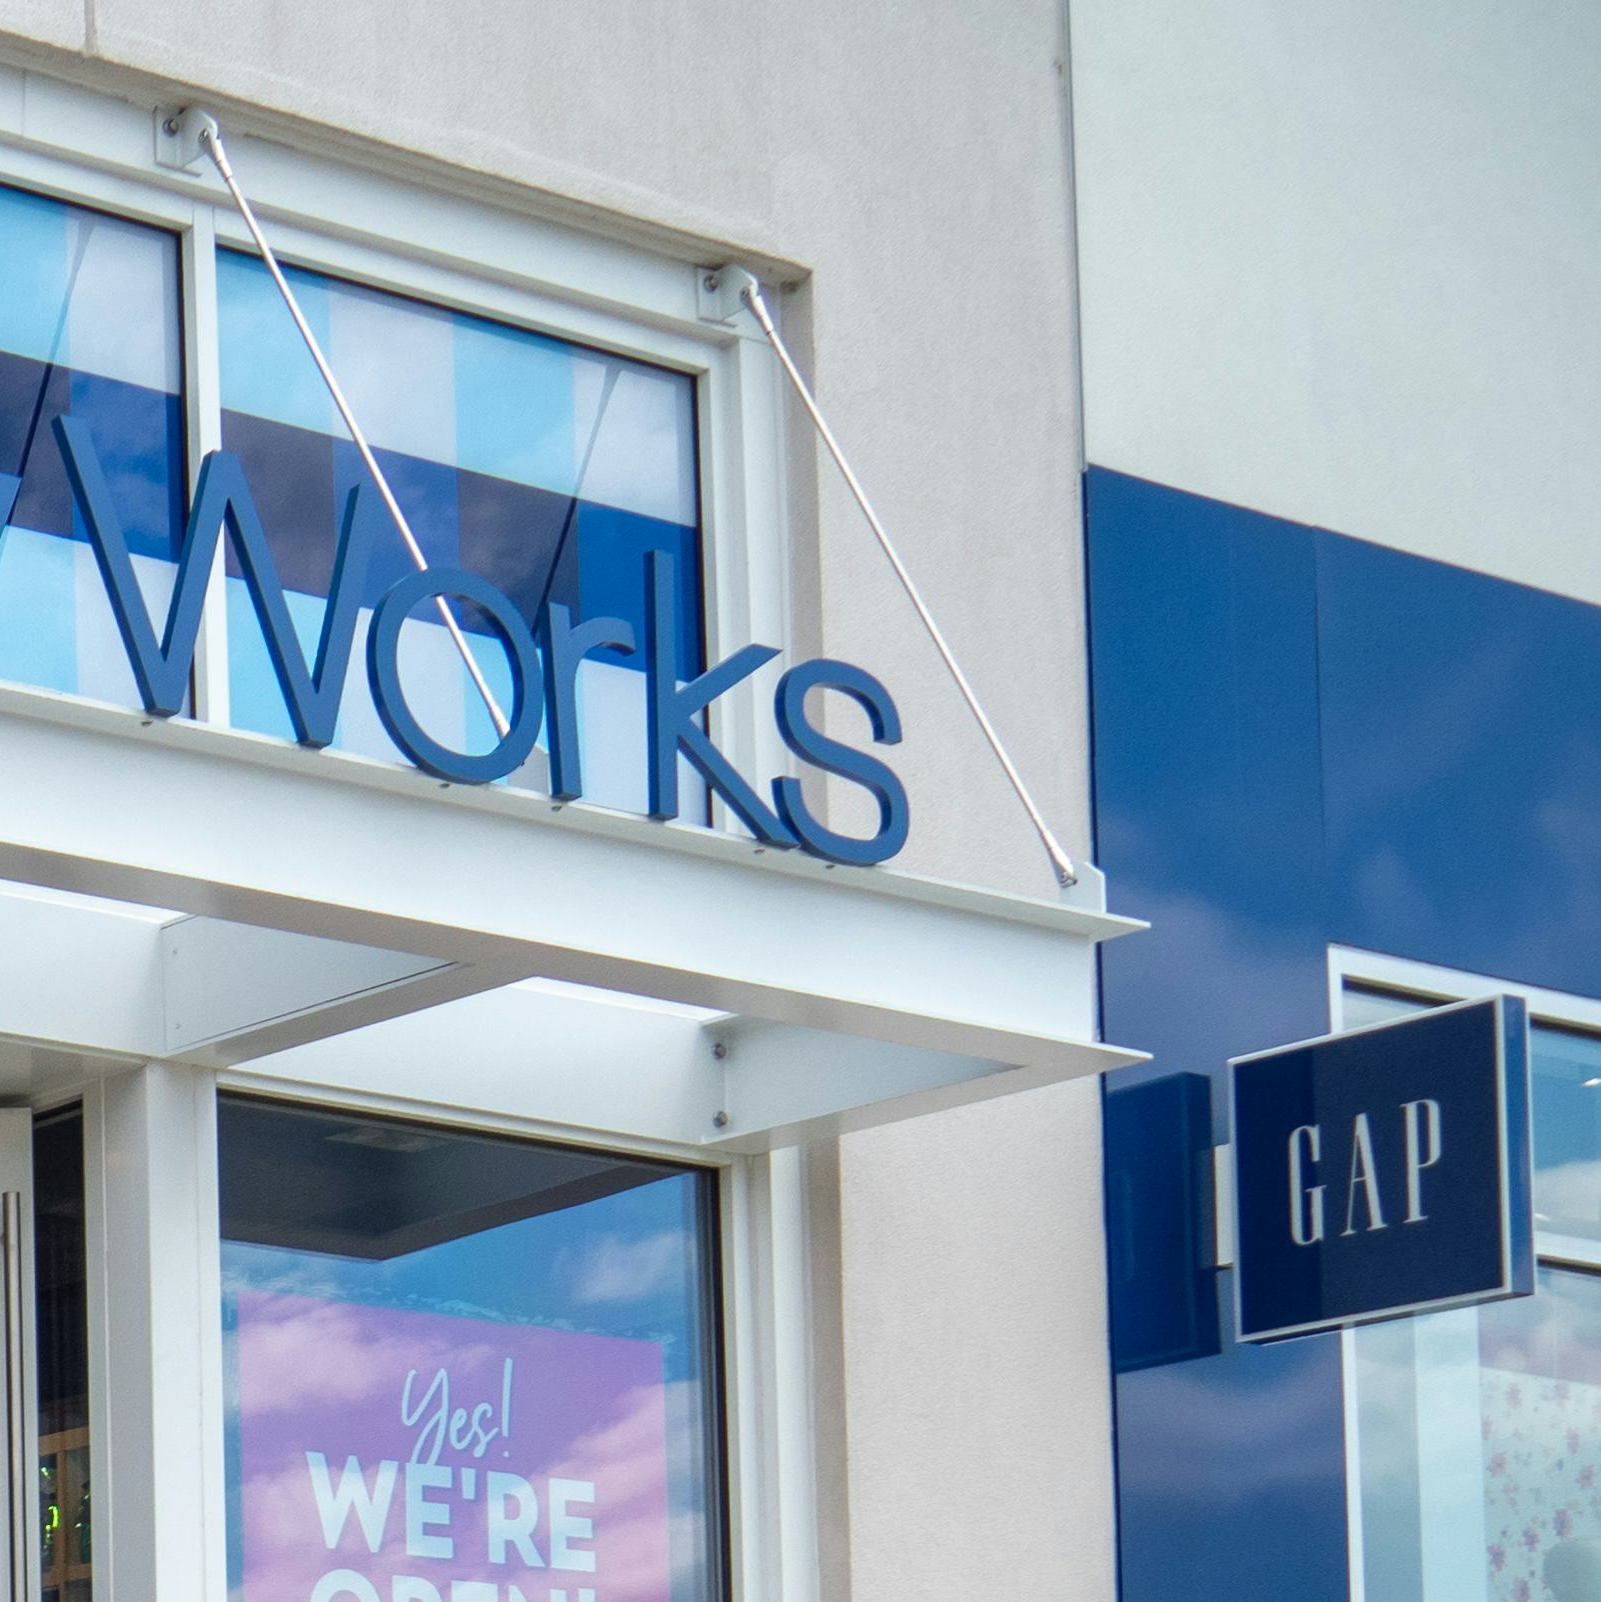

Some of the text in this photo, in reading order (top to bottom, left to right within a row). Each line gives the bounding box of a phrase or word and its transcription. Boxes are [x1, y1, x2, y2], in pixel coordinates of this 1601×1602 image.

[62, 408, 909, 866] Works
[1289, 1100, 1441, 1245] GAP
[401, 1358, 513, 1467] Yes!
[306, 1452, 596, 1573] WE'RE
